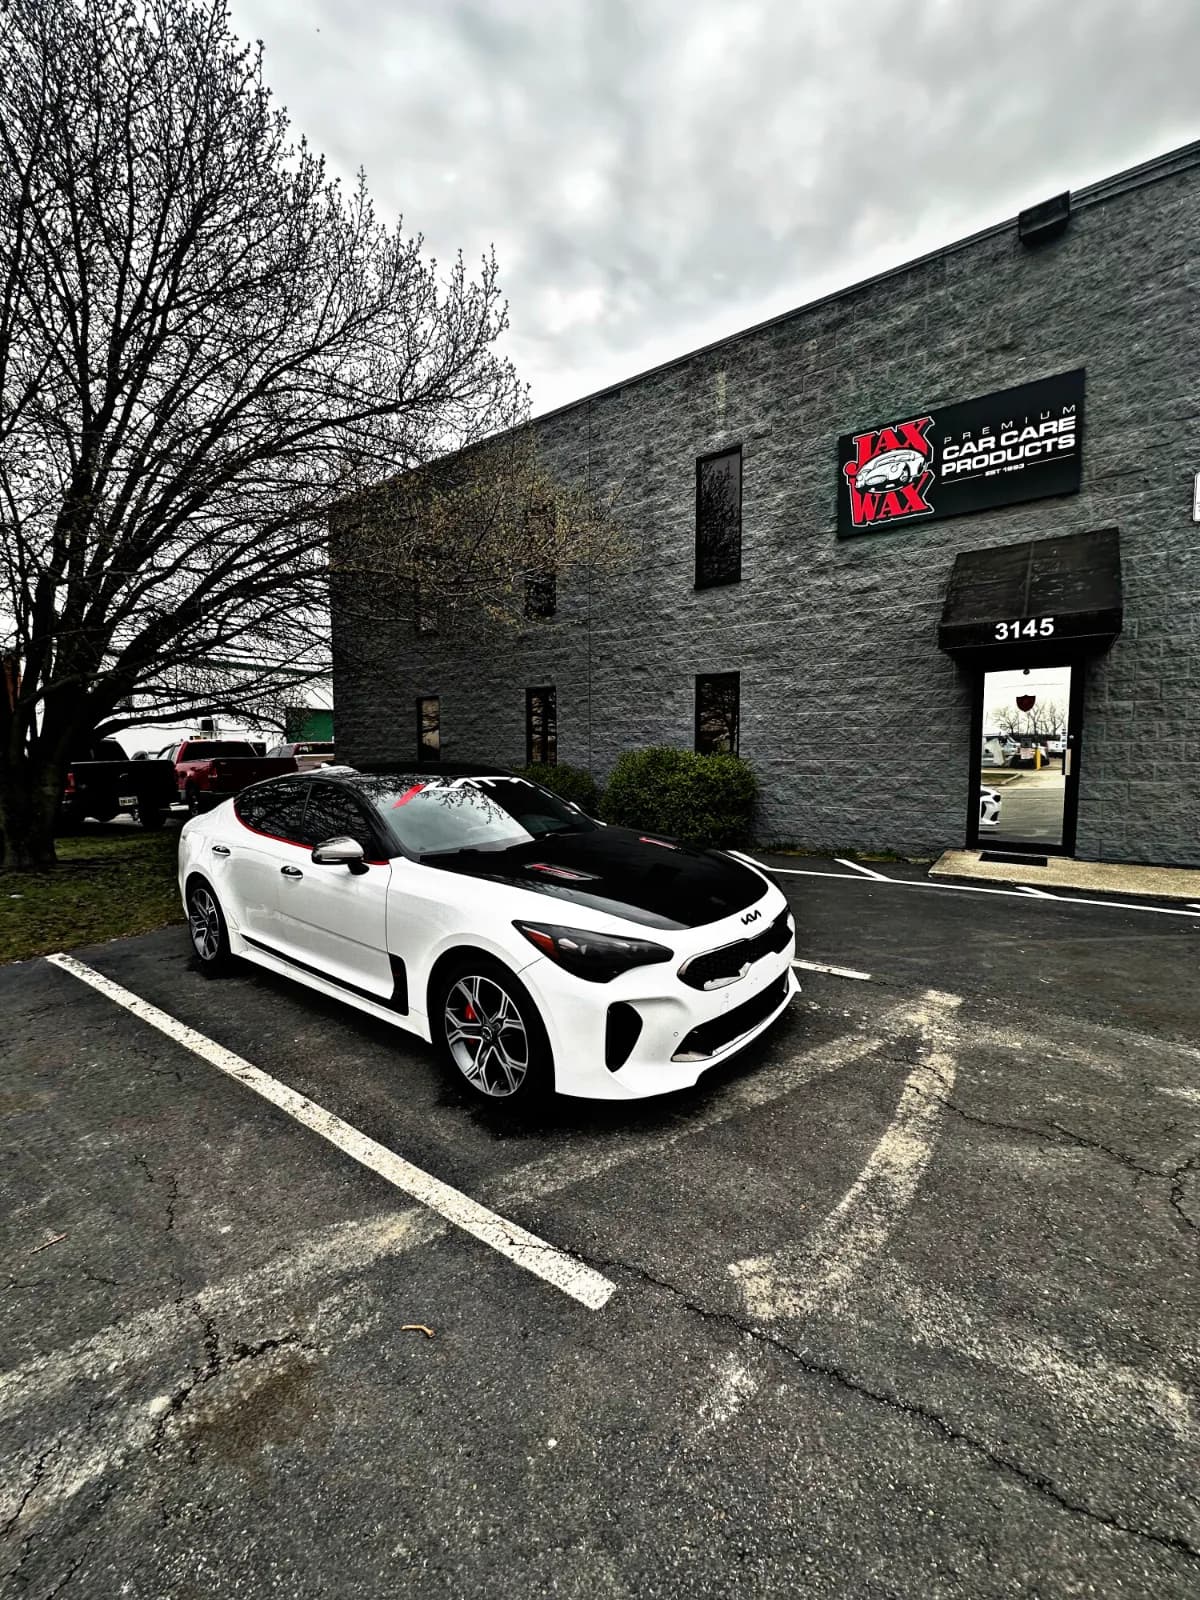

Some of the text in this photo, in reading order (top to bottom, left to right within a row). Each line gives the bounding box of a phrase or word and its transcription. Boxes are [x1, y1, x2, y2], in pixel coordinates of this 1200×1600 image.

[844, 417, 931, 477] JAX
[942, 415, 1077, 461] CAR CARE
[943, 404, 1076, 445] PREMIUM
[941, 433, 1076, 477] PRODUCTS
[848, 470, 930, 525] WAX
[994, 617, 1055, 641] 3145
